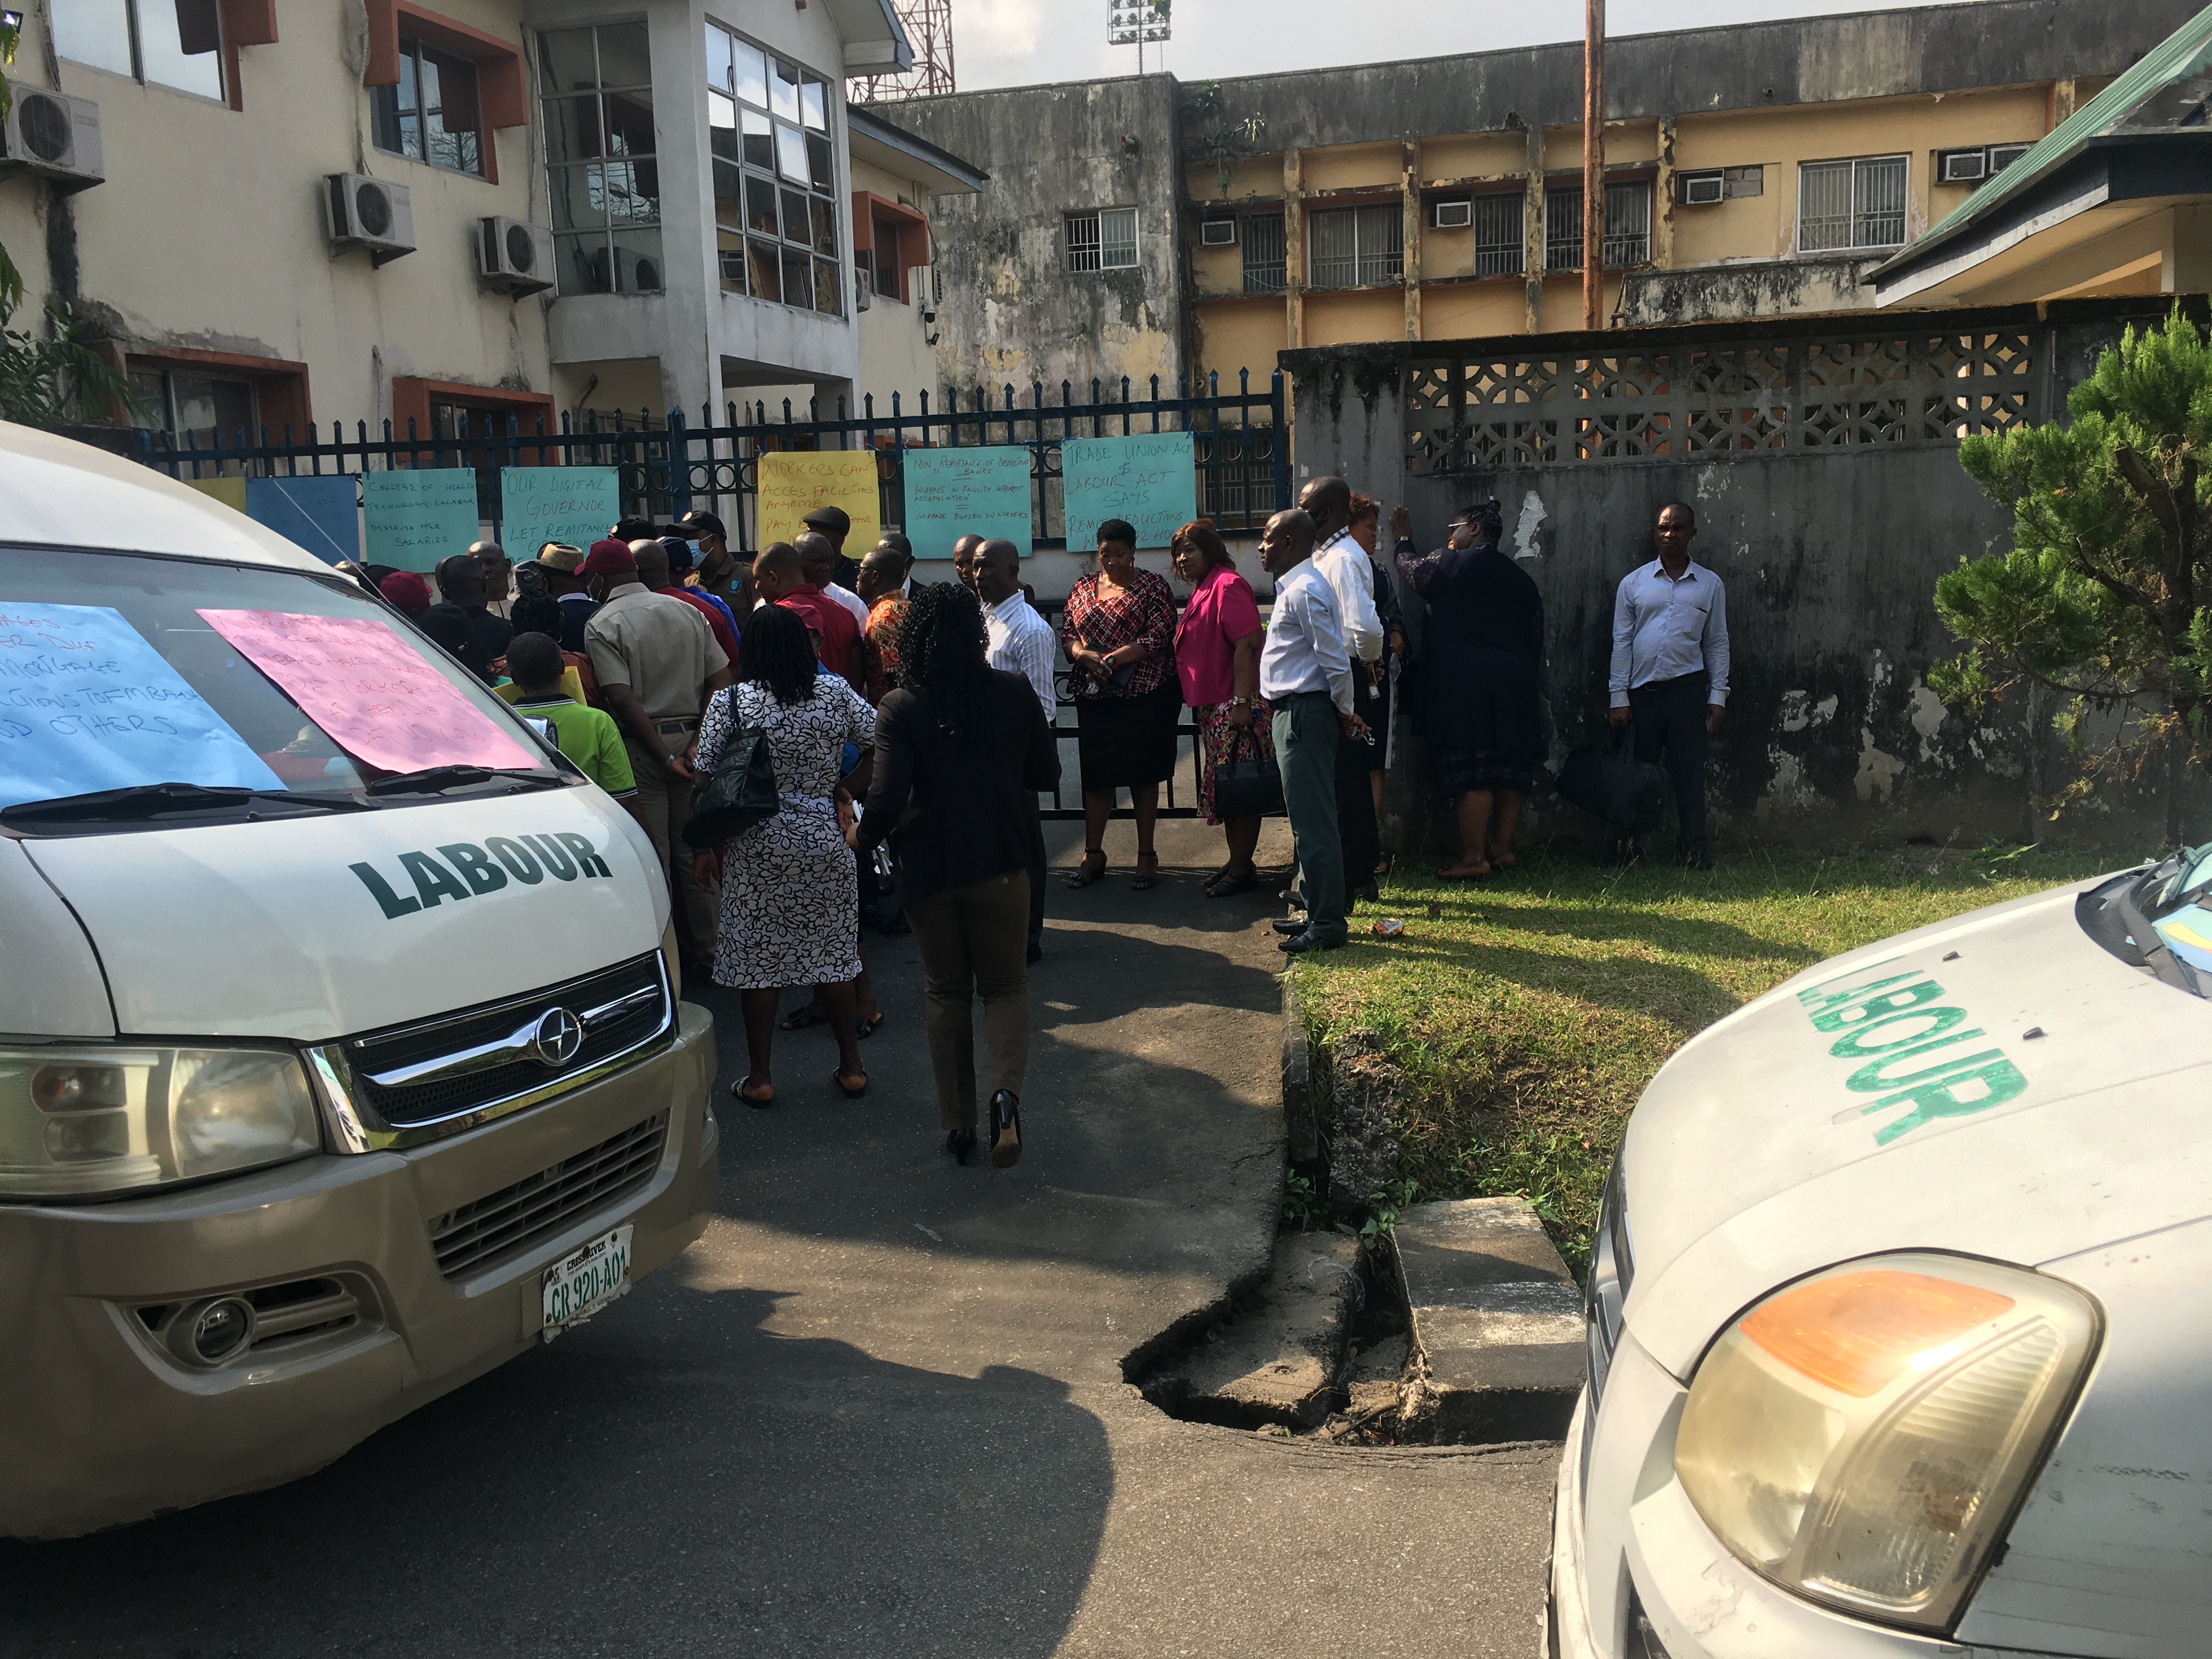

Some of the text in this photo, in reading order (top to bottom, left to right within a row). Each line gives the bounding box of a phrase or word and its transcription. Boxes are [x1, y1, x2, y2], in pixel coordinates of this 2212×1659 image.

[1065, 442, 1194, 466] TRADE UNION ACT
[761, 458, 834, 480] WORKERS
[914, 458, 931, 470] NON
[369, 482, 417, 491] COLLEGE
[445, 483, 475, 492] HEALTH
[507, 474, 607, 495] OUR DIGITAL
[915, 484, 945, 494] INCREASE
[1065, 471, 1175, 494] LABOUR ACT
[435, 498, 475, 506] CALABAR
[526, 496, 606, 520] GOVERNOR
[1103, 490, 1150, 508] SAYS
[510, 527, 539, 541] LET
[766, 518, 791, 534] PAY
[394, 537, 448, 546] SALARIES
[0, 614, 60, 629] AGES
[0, 633, 98, 652] ER DUE
[397, 724, 433, 742] US
[439, 721, 485, 742] NOW
[347, 832, 614, 920] LABOUR
[552, 1283, 571, 1323] CR
